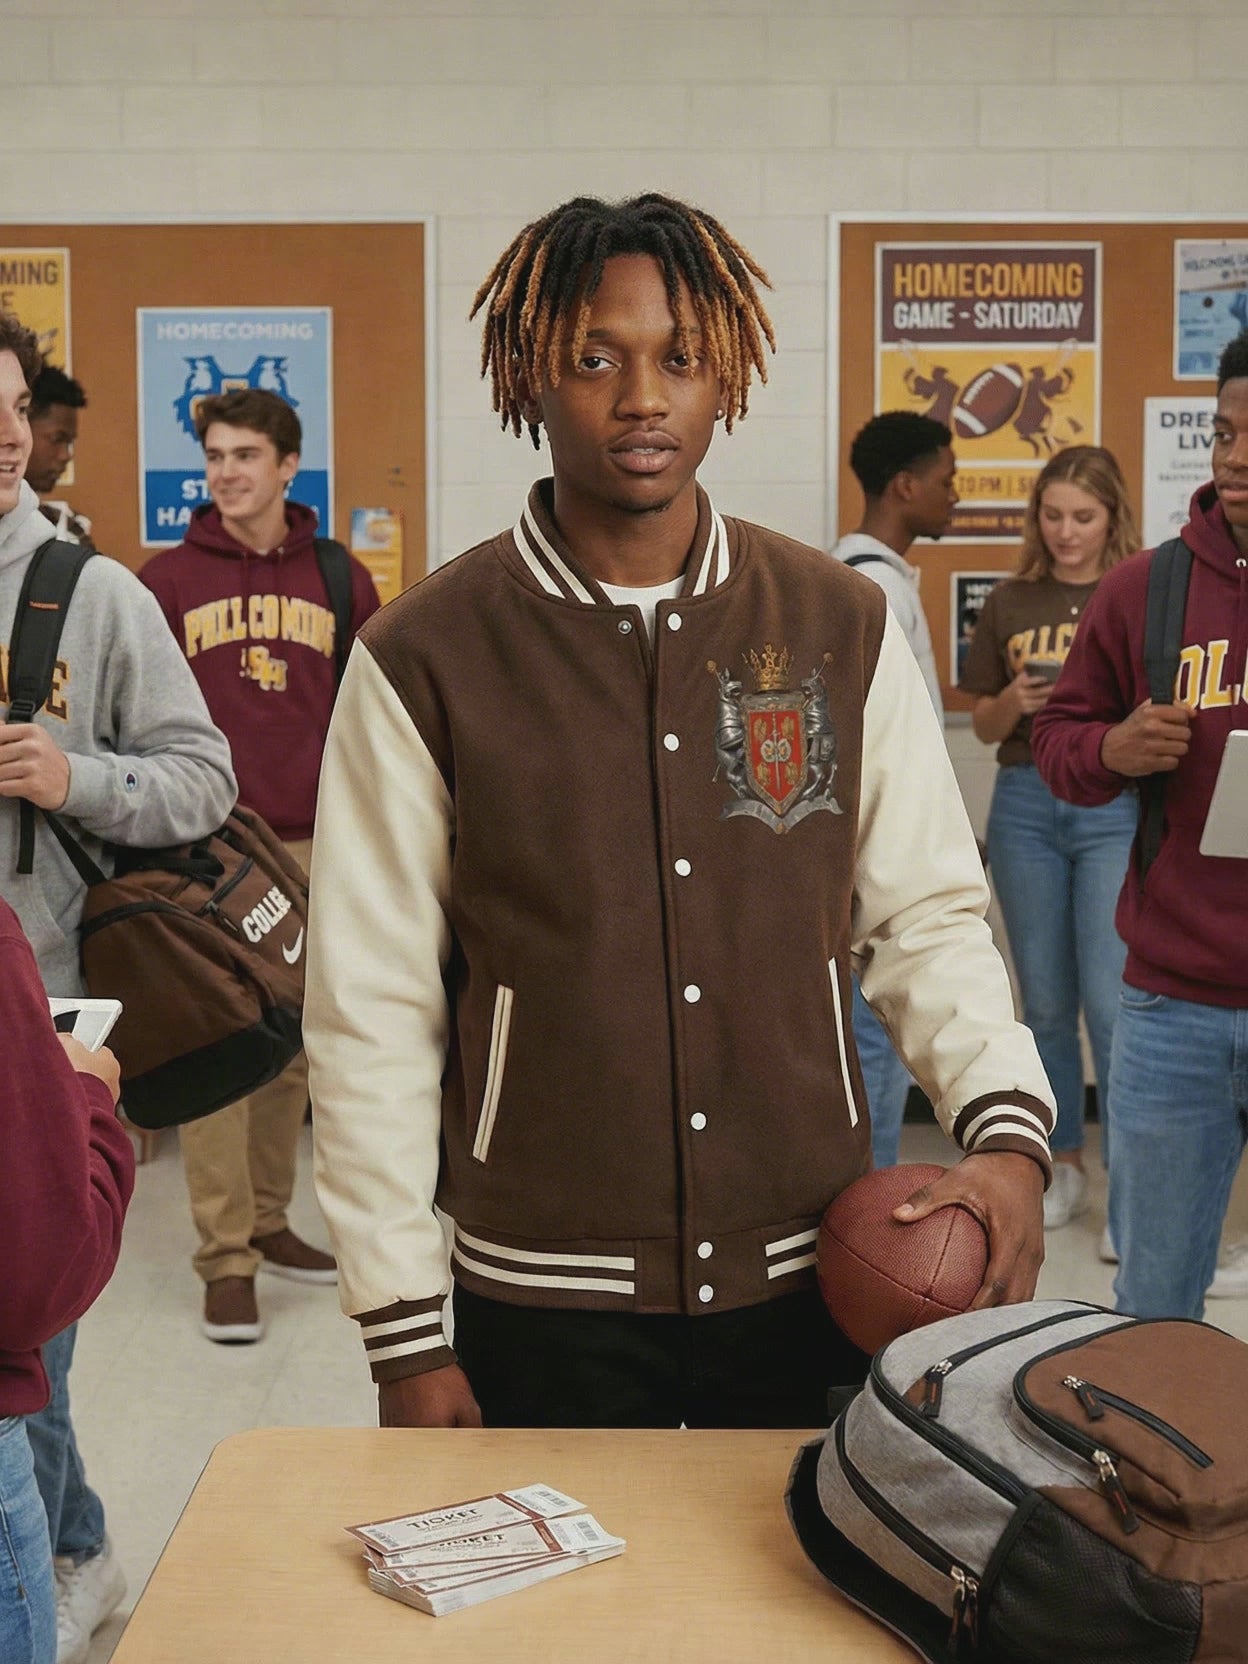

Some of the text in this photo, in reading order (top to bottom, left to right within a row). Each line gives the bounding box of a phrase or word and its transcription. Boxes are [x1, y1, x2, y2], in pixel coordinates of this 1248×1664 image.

[894, 263, 1084, 298] HOMECOMING
[893, 302, 956, 330] GAME
[974, 302, 1084, 330] SATURDAY
[156, 321, 314, 341] HOMECOMING
